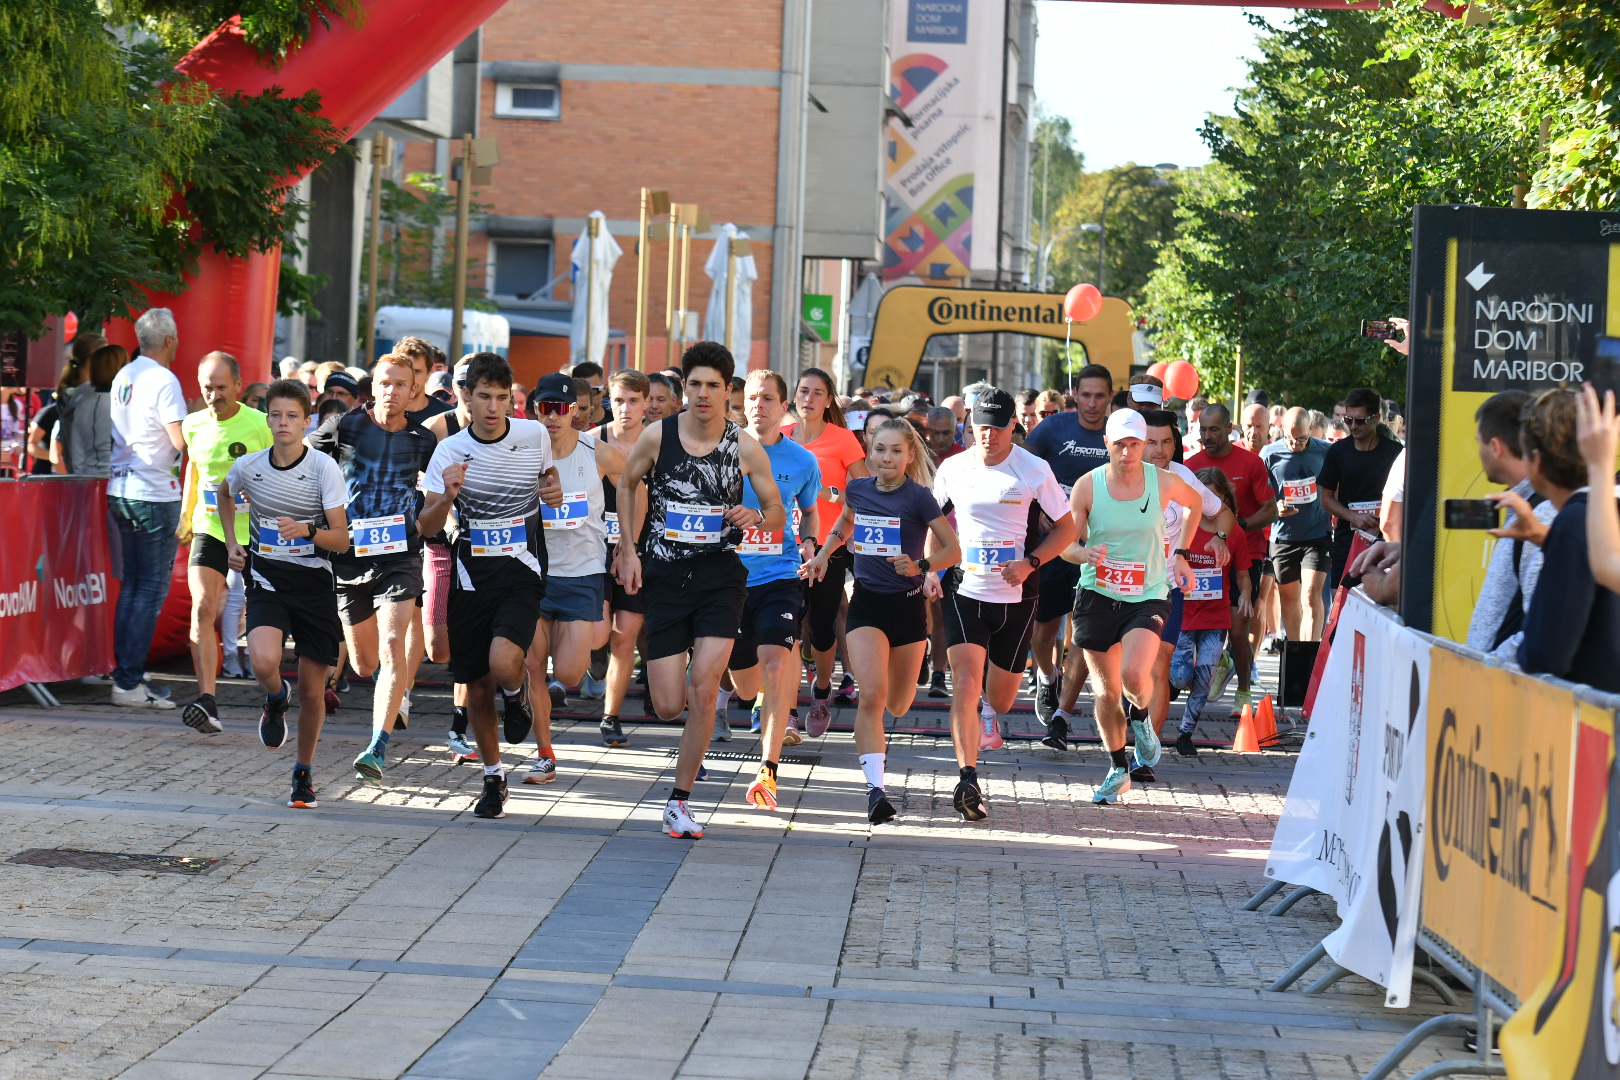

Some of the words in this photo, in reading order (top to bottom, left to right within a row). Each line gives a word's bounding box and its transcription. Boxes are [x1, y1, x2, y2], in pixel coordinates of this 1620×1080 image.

[915, 3, 962, 13] NARODNI
[915, 14, 941, 23] DOM
[915, 26, 959, 35] MARIBOR
[911, 108, 943, 141] pisarna
[900, 155, 935, 189] Prodaja
[934, 124, 971, 158] vstopnic
[908, 179, 927, 198] Box
[925, 157, 953, 184] Office
[928, 297, 1064, 325] Continental
[1475, 300, 1593, 323] NARODNI
[1474, 329, 1537, 350] DOM
[1473, 359, 1585, 382] MARIBOR
[1290, 485, 1311, 497] 250
[554, 504, 570, 520] 19
[681, 515, 705, 532] 64
[369, 527, 391, 544] 86
[482, 529, 512, 546] 139
[742, 529, 773, 544] 248
[864, 527, 884, 544] 23
[978, 548, 999, 565] 82
[1104, 568, 1134, 585] 234
[1432, 708, 1540, 897] Continental
